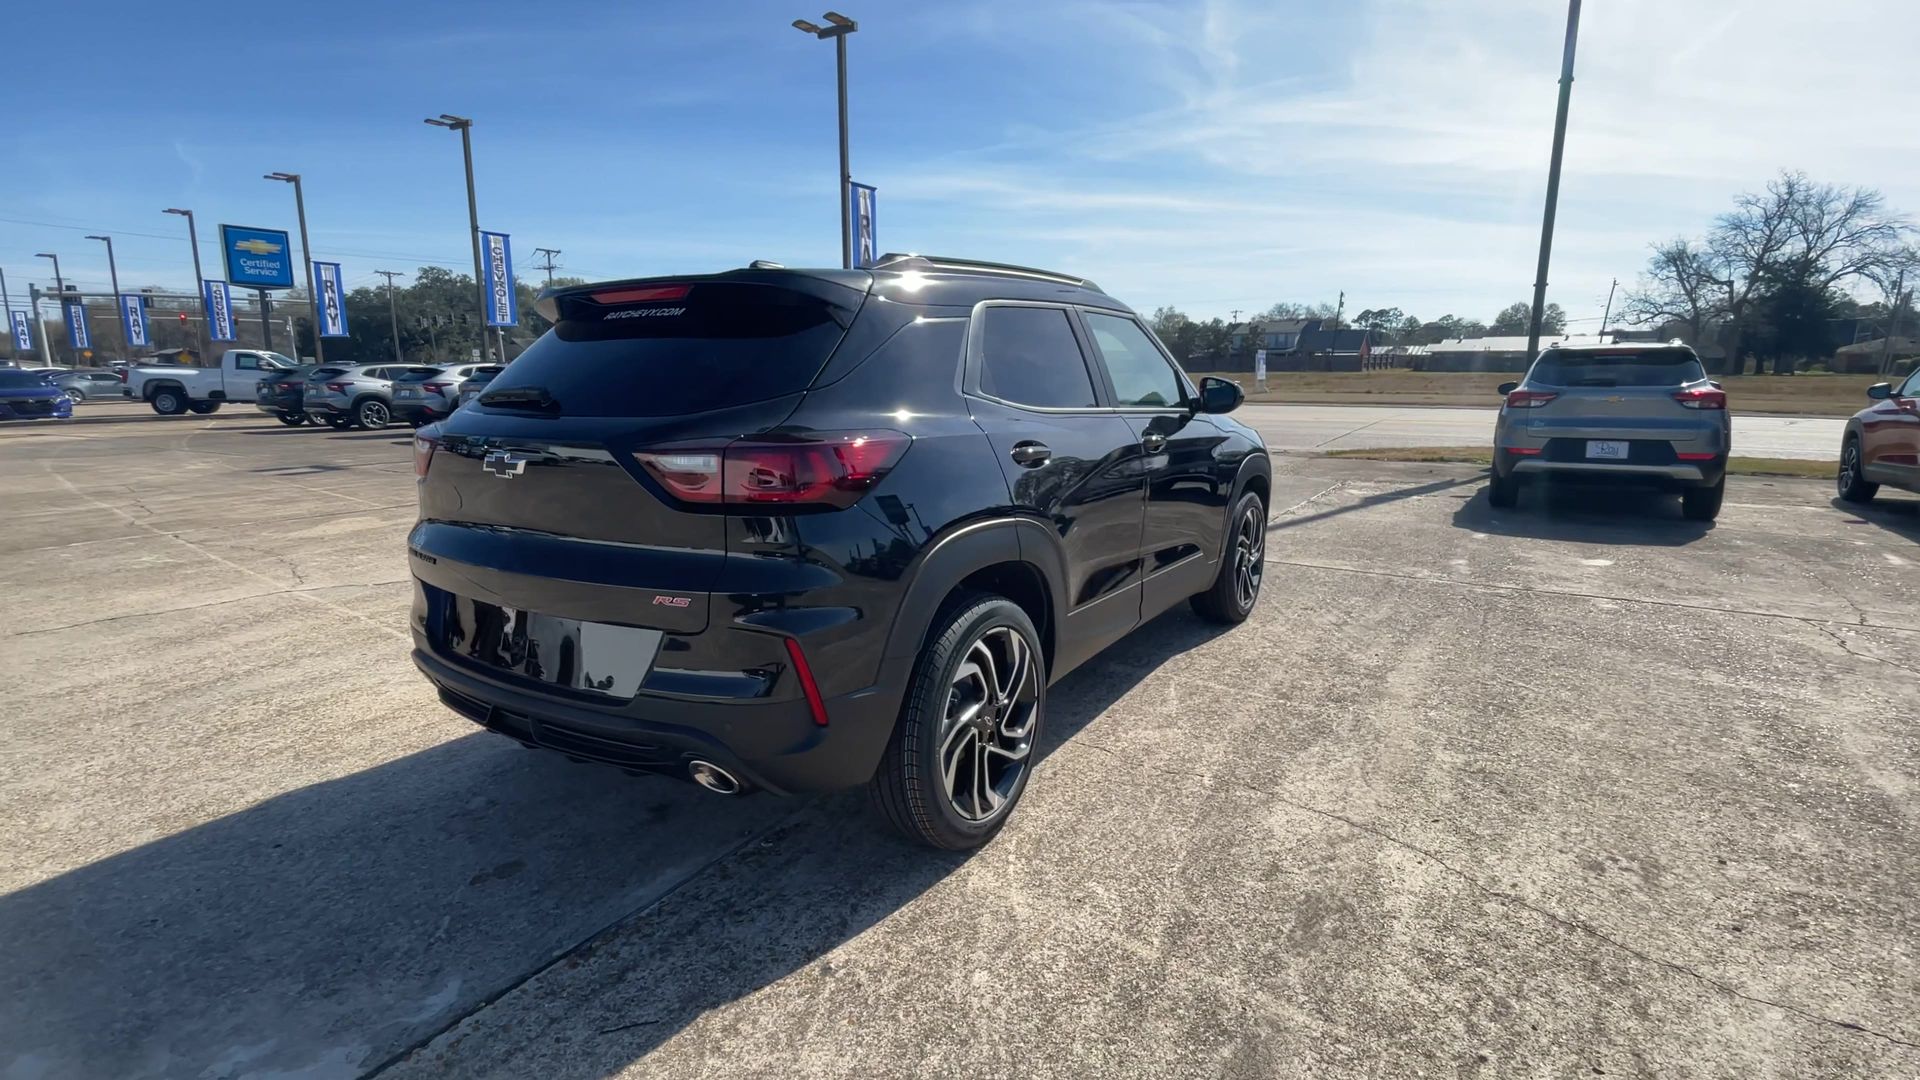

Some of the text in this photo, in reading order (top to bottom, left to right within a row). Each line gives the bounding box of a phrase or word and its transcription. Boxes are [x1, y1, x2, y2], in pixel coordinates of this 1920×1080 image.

[860, 214, 872, 267] RA
[240, 258, 280, 269] Certified
[244, 266, 279, 276] Service
[492, 246, 508, 322] CHEVROLET
[324, 280, 339, 327] RAY
[603, 307, 686, 321] RAYCHEVY.COM
[18, 320, 29, 345] RAY
[129, 306, 142, 340] RAY
[652, 595, 691, 607] RS
